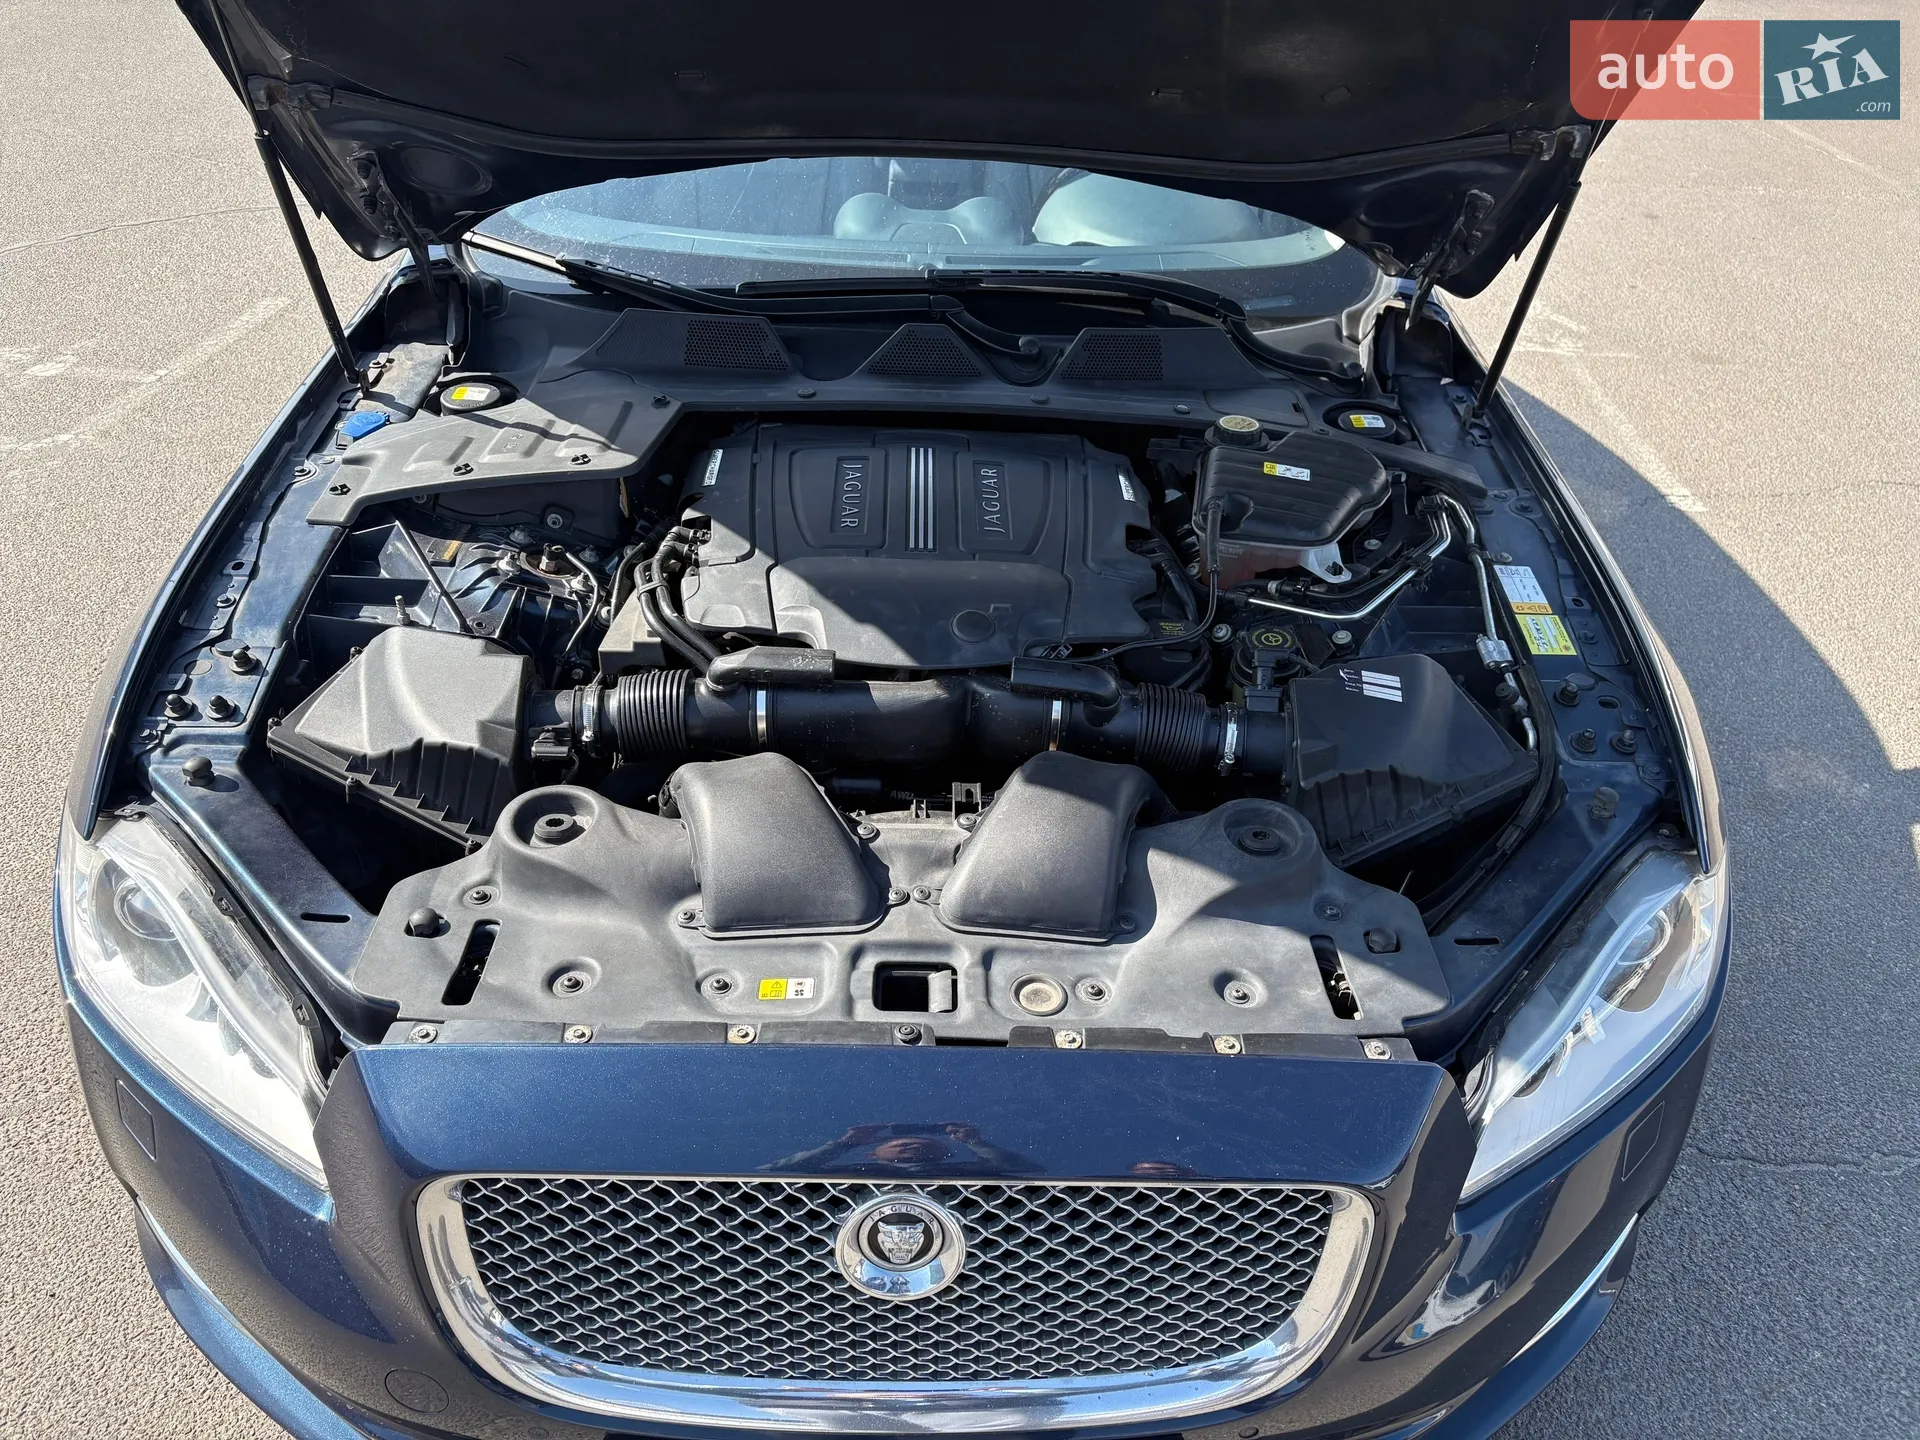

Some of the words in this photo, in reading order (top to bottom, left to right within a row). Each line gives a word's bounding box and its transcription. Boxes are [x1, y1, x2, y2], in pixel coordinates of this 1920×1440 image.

[840, 464, 863, 528] JAGUAR
[980, 468, 1006, 533] JAGUAR
[869, 1205, 935, 1225] JAGUAR
